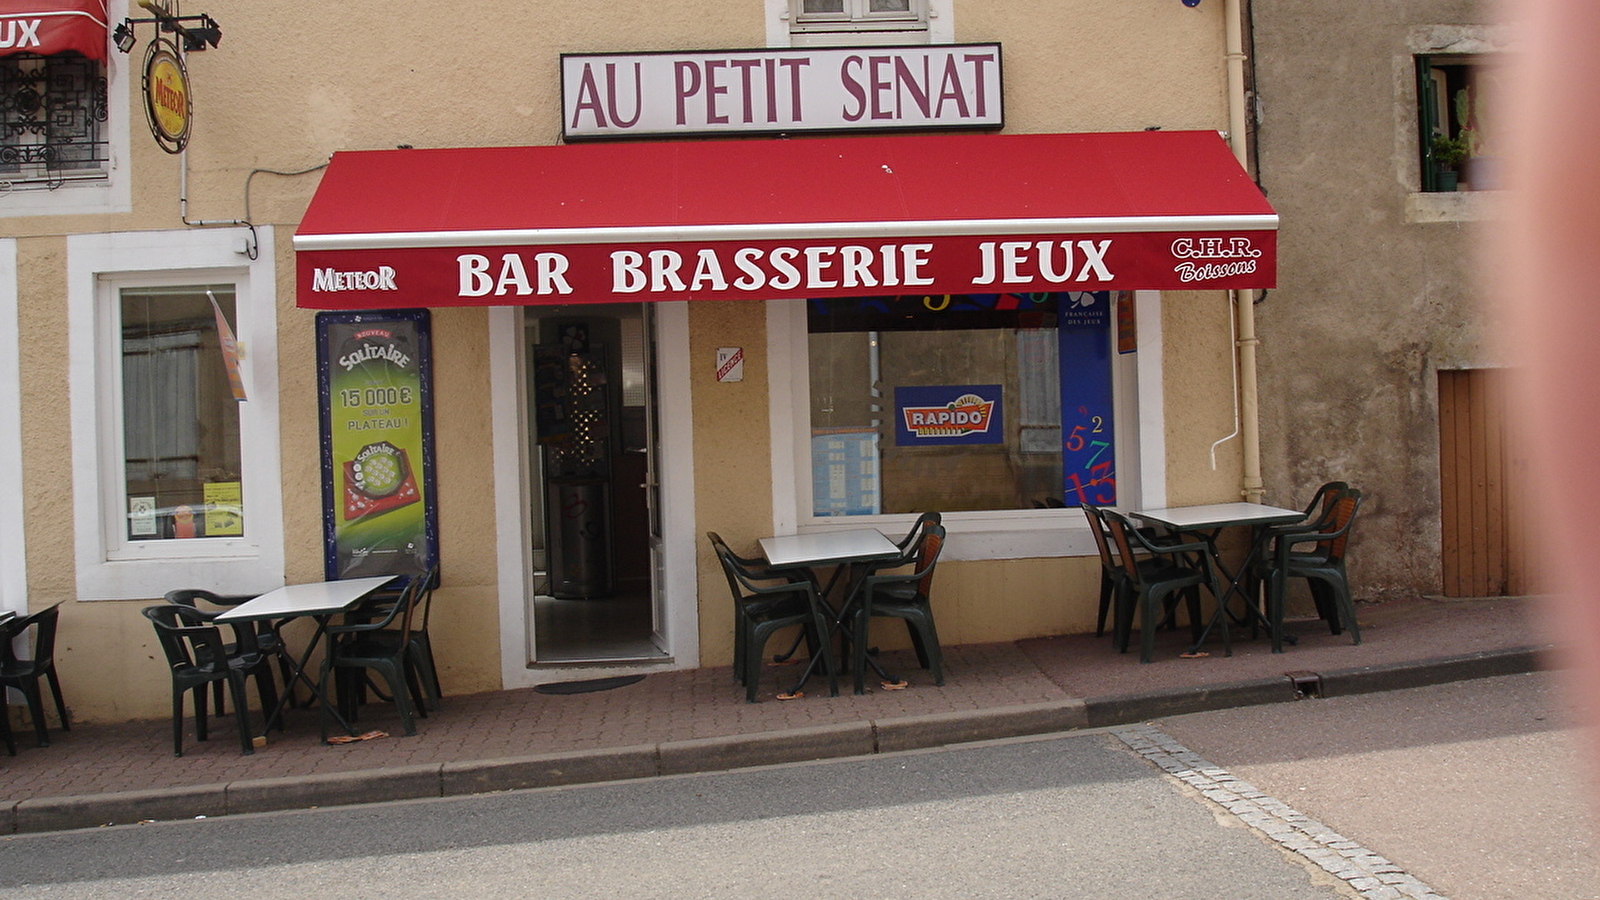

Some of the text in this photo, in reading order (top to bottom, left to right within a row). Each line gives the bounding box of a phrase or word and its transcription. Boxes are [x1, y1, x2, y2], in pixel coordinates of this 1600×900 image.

[0, 19, 42, 48] UX
[155, 75, 186, 119] METEOR
[571, 53, 995, 129] AU PETIT SENAT
[1171, 237, 1262, 259] C.H.R.
[312, 239, 1115, 297] METEOR BAR BRASSERIE JEUX
[1174, 260, 1257, 282] Boissons
[347, 418, 401, 430] PLATEAU
[911, 410, 982, 426] RAPIDO
[1091, 416, 1104, 433] 2
[1065, 425, 1088, 452] 5
[1085, 440, 1110, 469] 7
